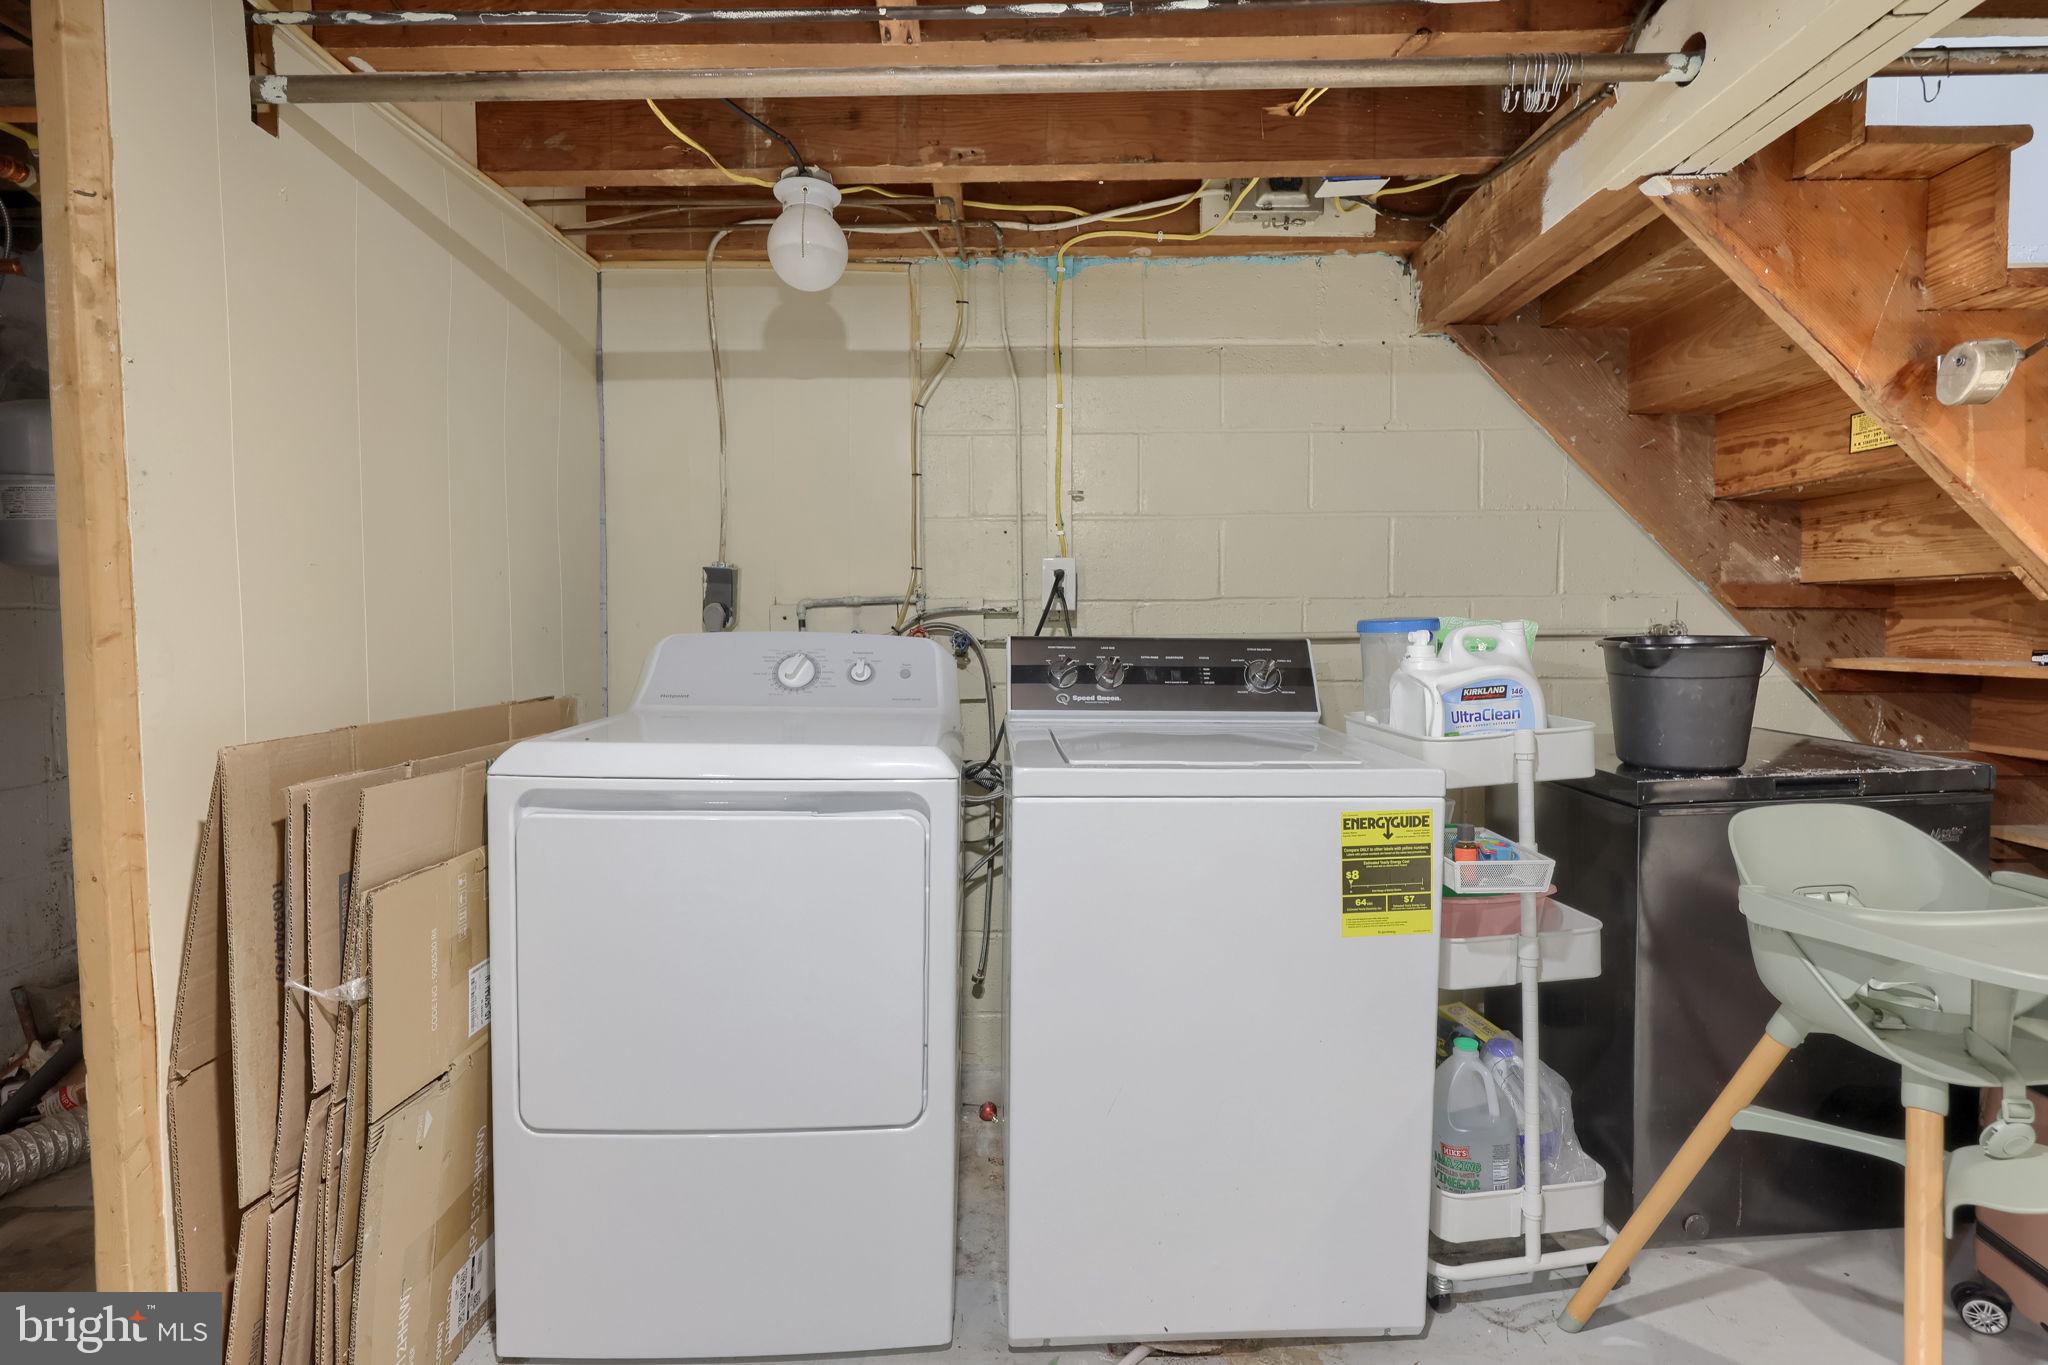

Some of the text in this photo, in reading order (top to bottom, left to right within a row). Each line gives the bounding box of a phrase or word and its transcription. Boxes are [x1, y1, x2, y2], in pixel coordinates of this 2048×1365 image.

[1463, 686, 1505, 696] KIRKLAND
[1451, 708, 1521, 724] UltraClean
[1343, 815, 1430, 832] ENERGYGUIDE
[1345, 870, 1359, 880] $8
[1355, 898, 1367, 906] 64
[1403, 895, 1415, 903] $7
[1443, 1146, 1468, 1157] MIKE'S
[1434, 1166, 1481, 1191] VINEGAR
